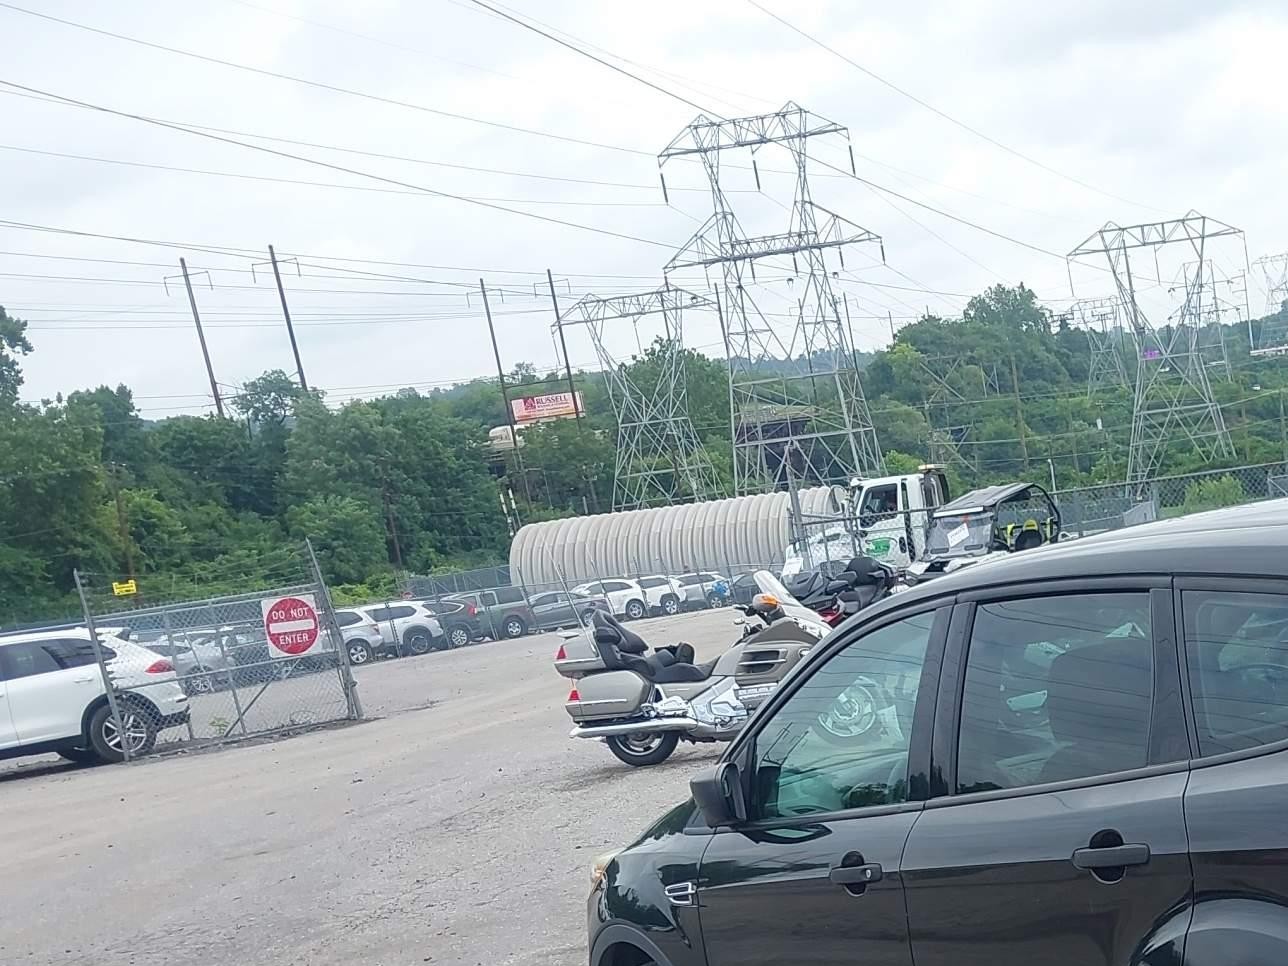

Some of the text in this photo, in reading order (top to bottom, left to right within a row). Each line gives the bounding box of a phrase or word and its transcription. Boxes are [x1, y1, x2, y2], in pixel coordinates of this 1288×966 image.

[535, 394, 569, 405] RUSSELL
[272, 606, 309, 620] DO NOT
[279, 632, 310, 645] ENTER
